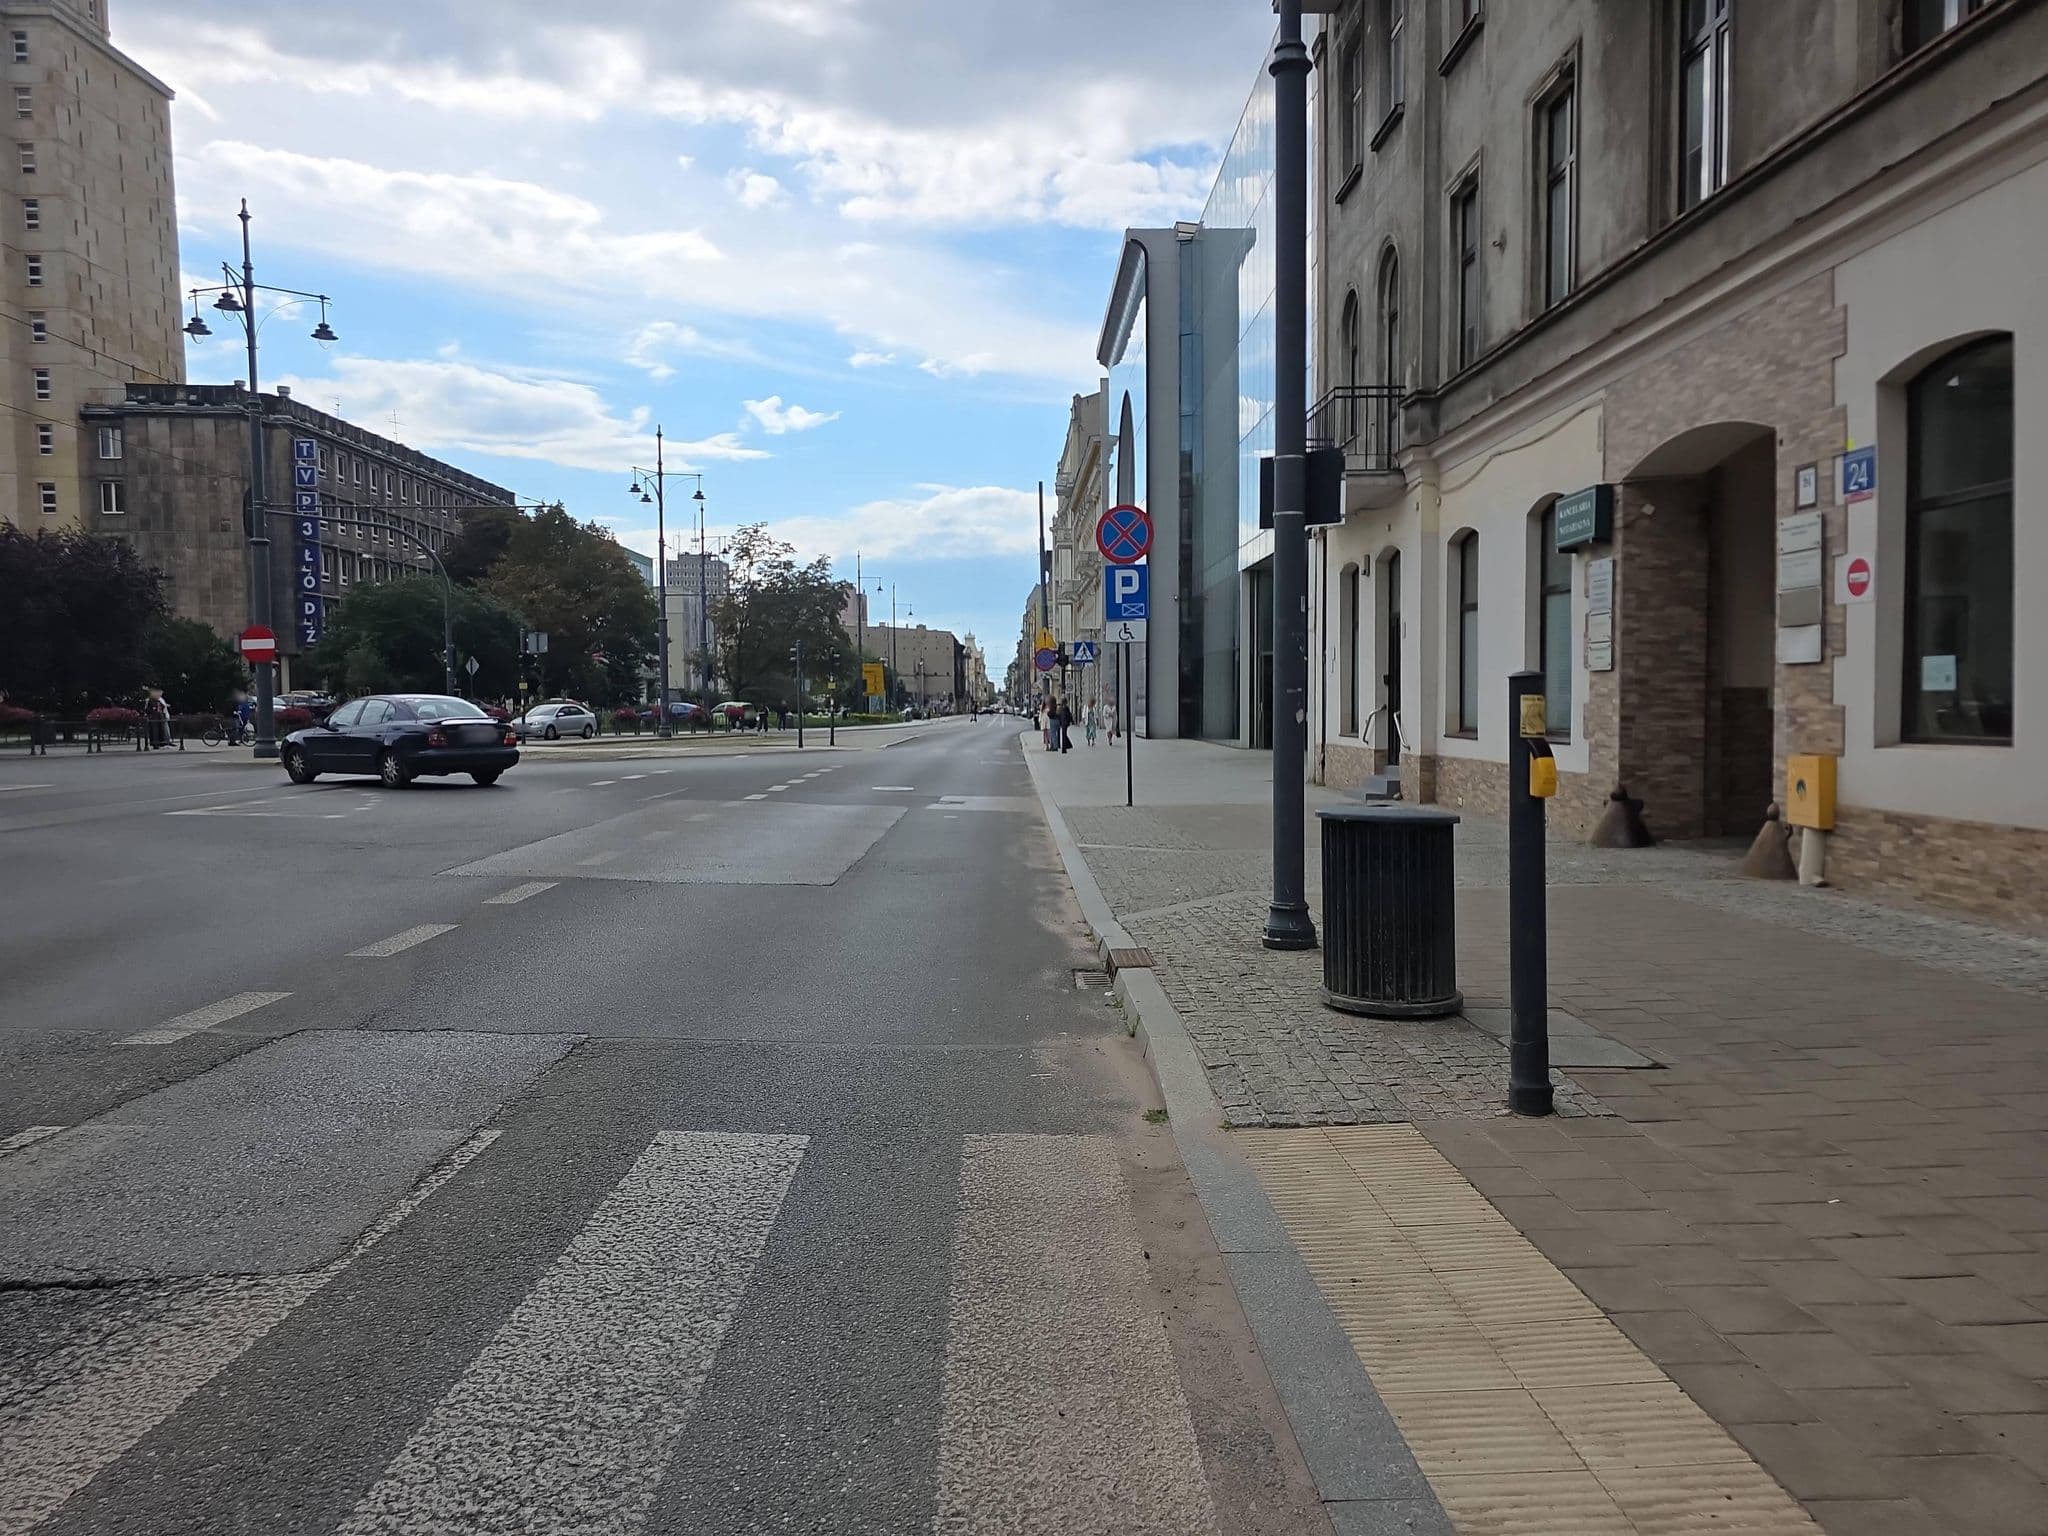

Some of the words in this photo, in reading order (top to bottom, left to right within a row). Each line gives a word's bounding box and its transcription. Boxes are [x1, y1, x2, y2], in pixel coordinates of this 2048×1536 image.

[299, 443, 312, 508] TVP
[1849, 459, 1869, 490] 24
[1559, 500, 1591, 519] KANCELARIA
[302, 522, 312, 536] 3
[303, 548, 316, 643] ŁÓDŹ
[1115, 569, 1139, 604] P
